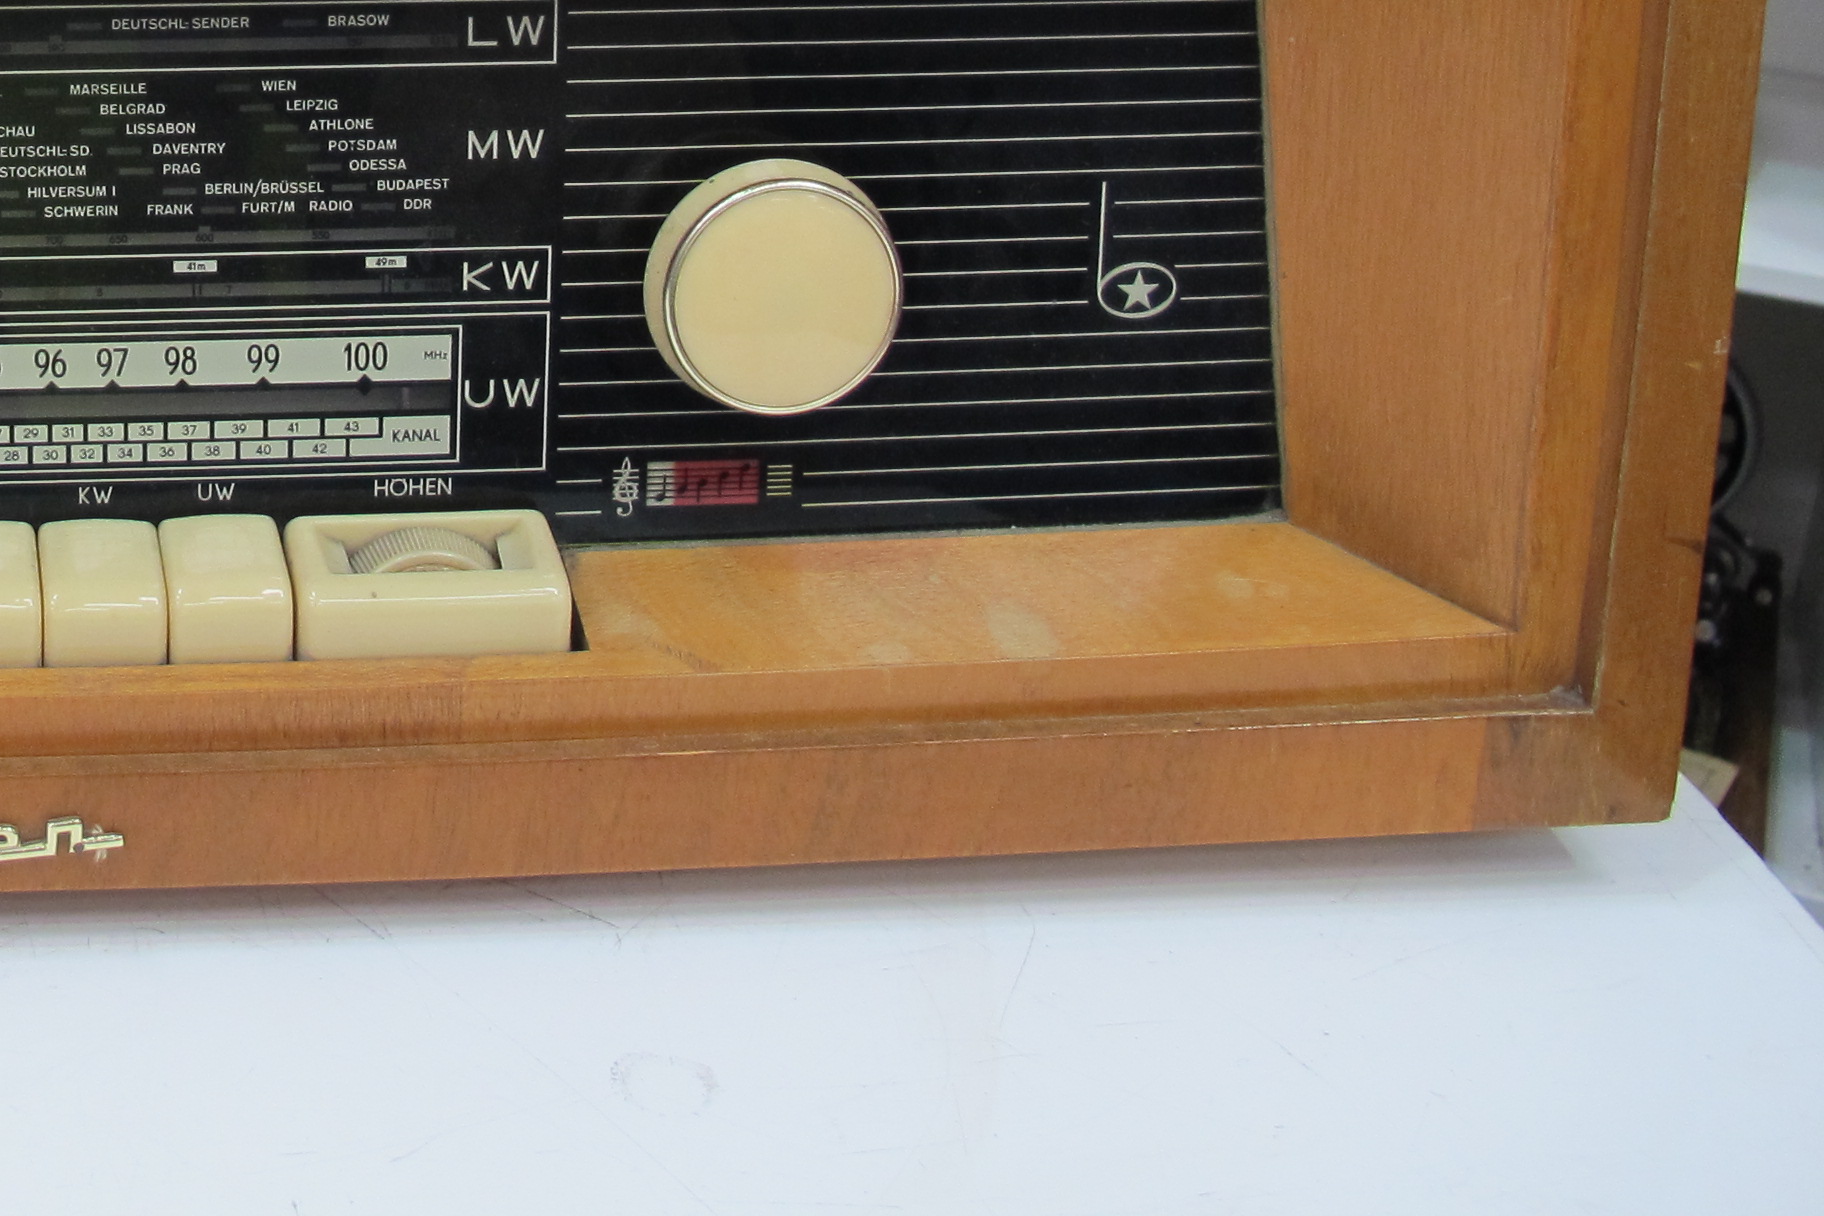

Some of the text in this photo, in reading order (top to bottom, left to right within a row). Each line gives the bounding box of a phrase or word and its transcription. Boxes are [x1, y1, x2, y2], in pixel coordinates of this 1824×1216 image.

[328, 14, 390, 27] BRASOW
[467, 15, 545, 47] LW
[69, 83, 147, 95] MARSEILLE
[261, 80, 297, 92] WIEN
[99, 103, 165, 116] BELGRAD
[286, 99, 338, 111] LEIPZIG
[126, 122, 196, 135] LISSABON
[309, 118, 374, 131] ATHLONE
[152, 143, 226, 155] DAVENTRY
[328, 139, 397, 152] POTSDAM
[467, 129, 545, 159] MW
[163, 163, 201, 175] PRAG
[349, 159, 407, 171] ODESSA
[0, 165, 87, 178] STOCKHOLM
[377, 178, 450, 191] BUDAPEST
[27, 186, 108, 198] HILVERSUM
[146, 204, 194, 216] FRANK
[242, 199, 353, 214] FURT/M RADIO
[403, 199, 432, 210] DDR
[44, 205, 118, 218] SCHWERIN
[462, 261, 540, 291] KW
[164, 346, 198, 376] 98
[247, 344, 280, 373] 99
[343, 341, 388, 371] 100
[423, 350, 448, 361] MHz
[34, 349, 67, 378] 96
[96, 348, 129, 377] 97
[464, 378, 541, 408] UW
[62, 427, 75, 438] 31
[98, 427, 114, 437] 33
[138, 426, 154, 436] 35
[182, 425, 197, 436] 37
[231, 424, 247, 434] 39
[287, 423, 299, 433] 41
[344, 421, 359, 432] 43
[23, 428, 39, 439] 29
[391, 429, 441, 443] KANAL
[79, 449, 95, 459] 32
[117, 448, 133, 458] 34
[159, 447, 175, 457] 36
[204, 446, 220, 456] 38
[256, 445, 271, 455] 40
[312, 443, 327, 454] 42
[4, 450, 20, 461] 28
[42, 450, 59, 460] 30
[197, 483, 235, 501] UW
[374, 477, 453, 497] HÖHEN
[78, 486, 113, 504] KW
